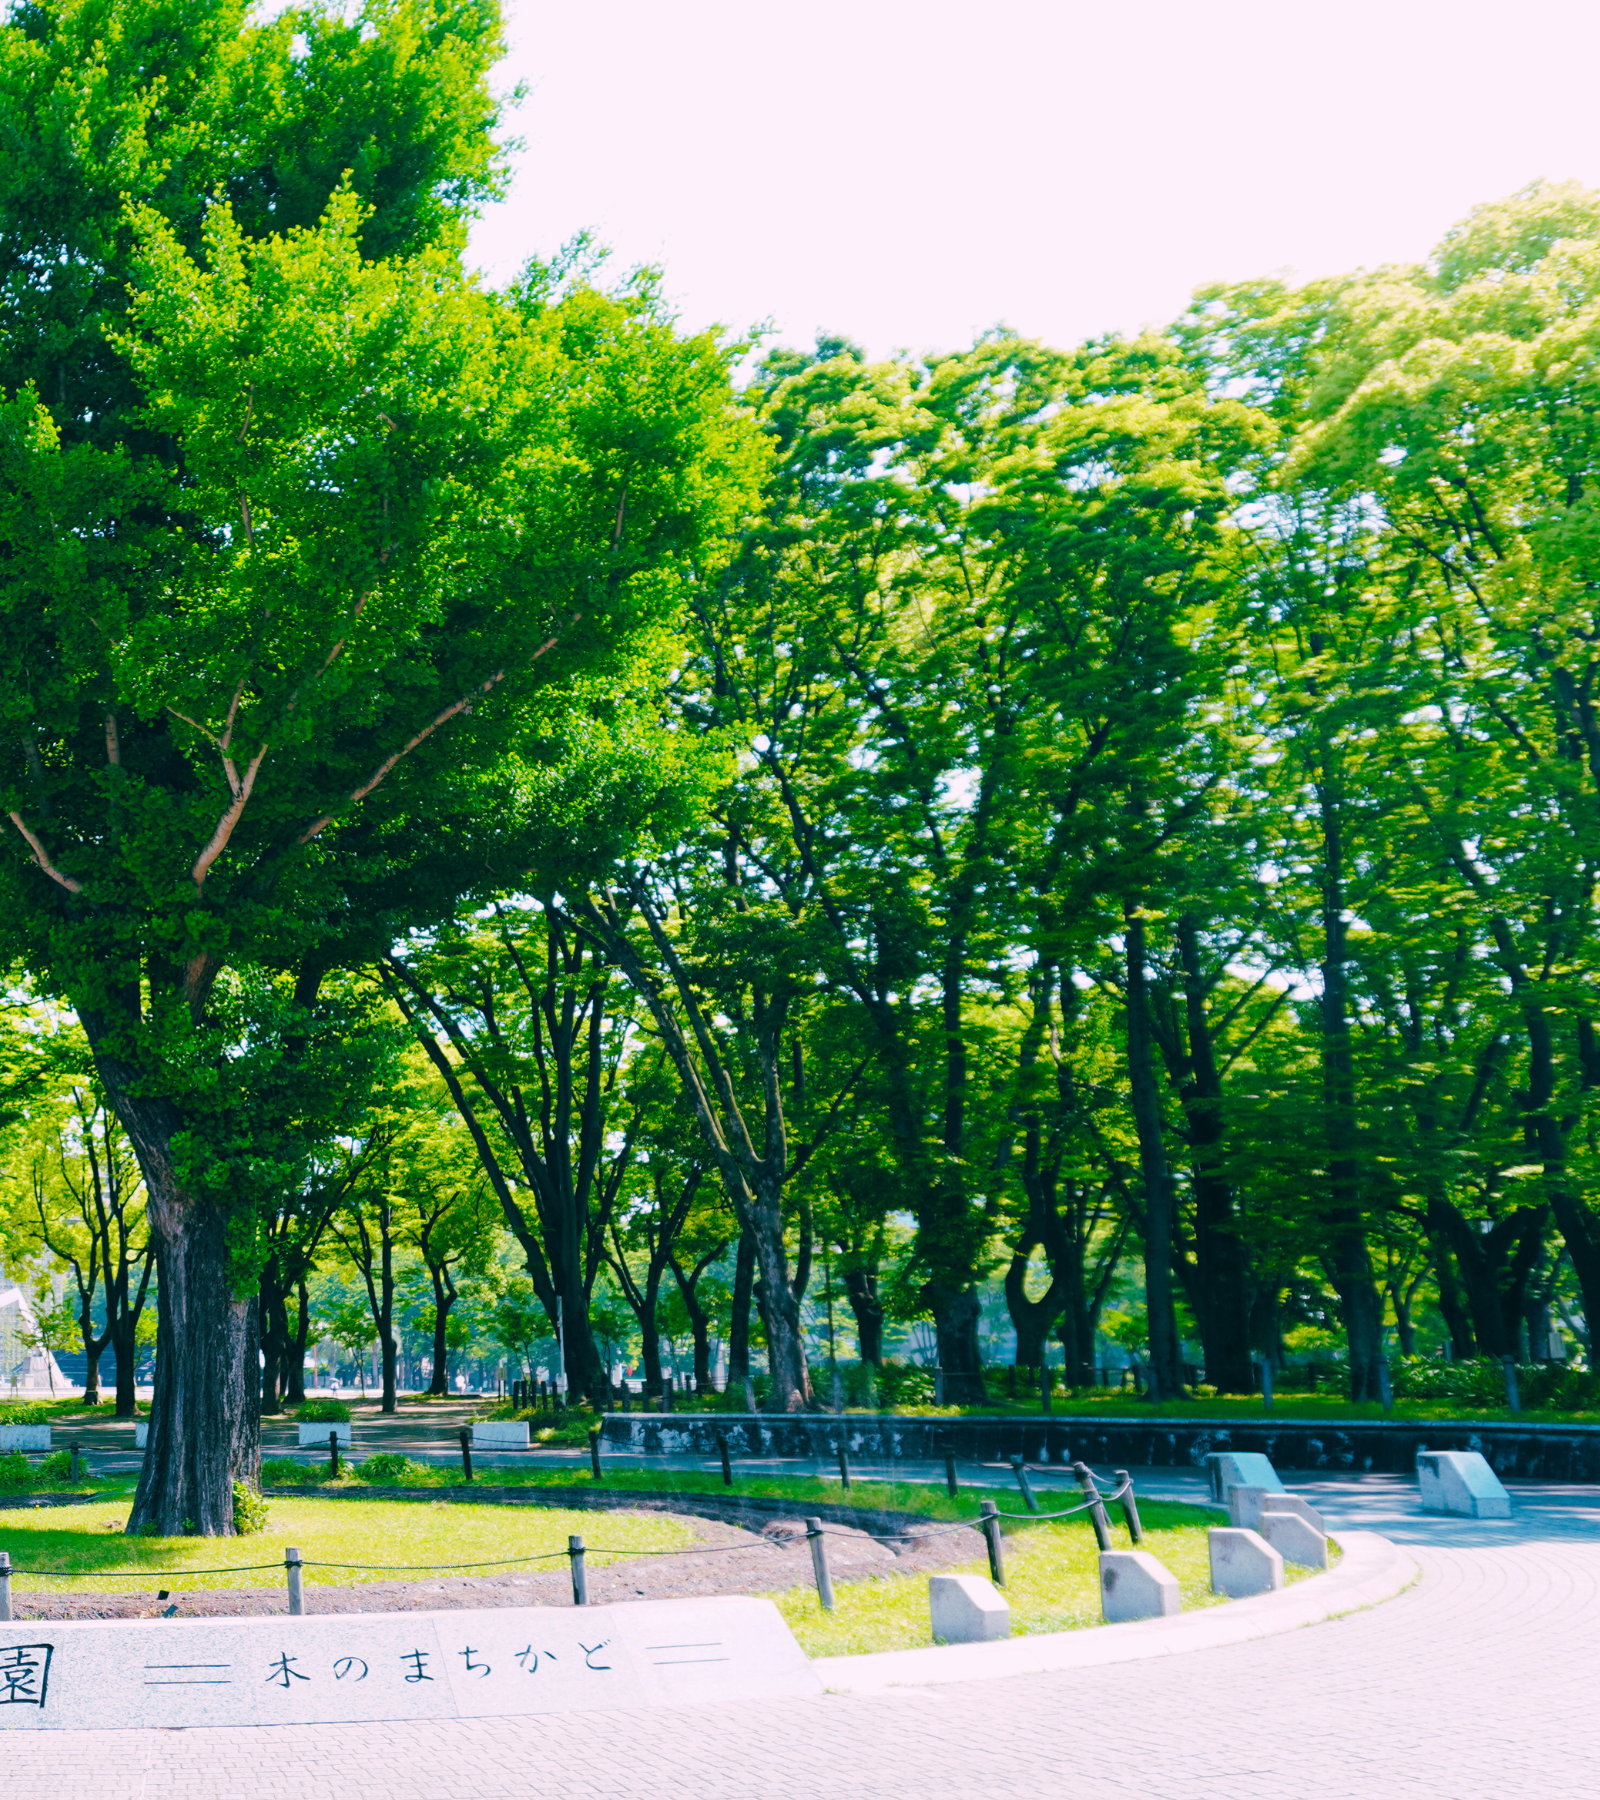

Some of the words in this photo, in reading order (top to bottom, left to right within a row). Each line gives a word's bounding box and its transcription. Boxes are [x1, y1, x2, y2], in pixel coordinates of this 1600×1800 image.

[265, 1639, 612, 1688] 木のまちかど
